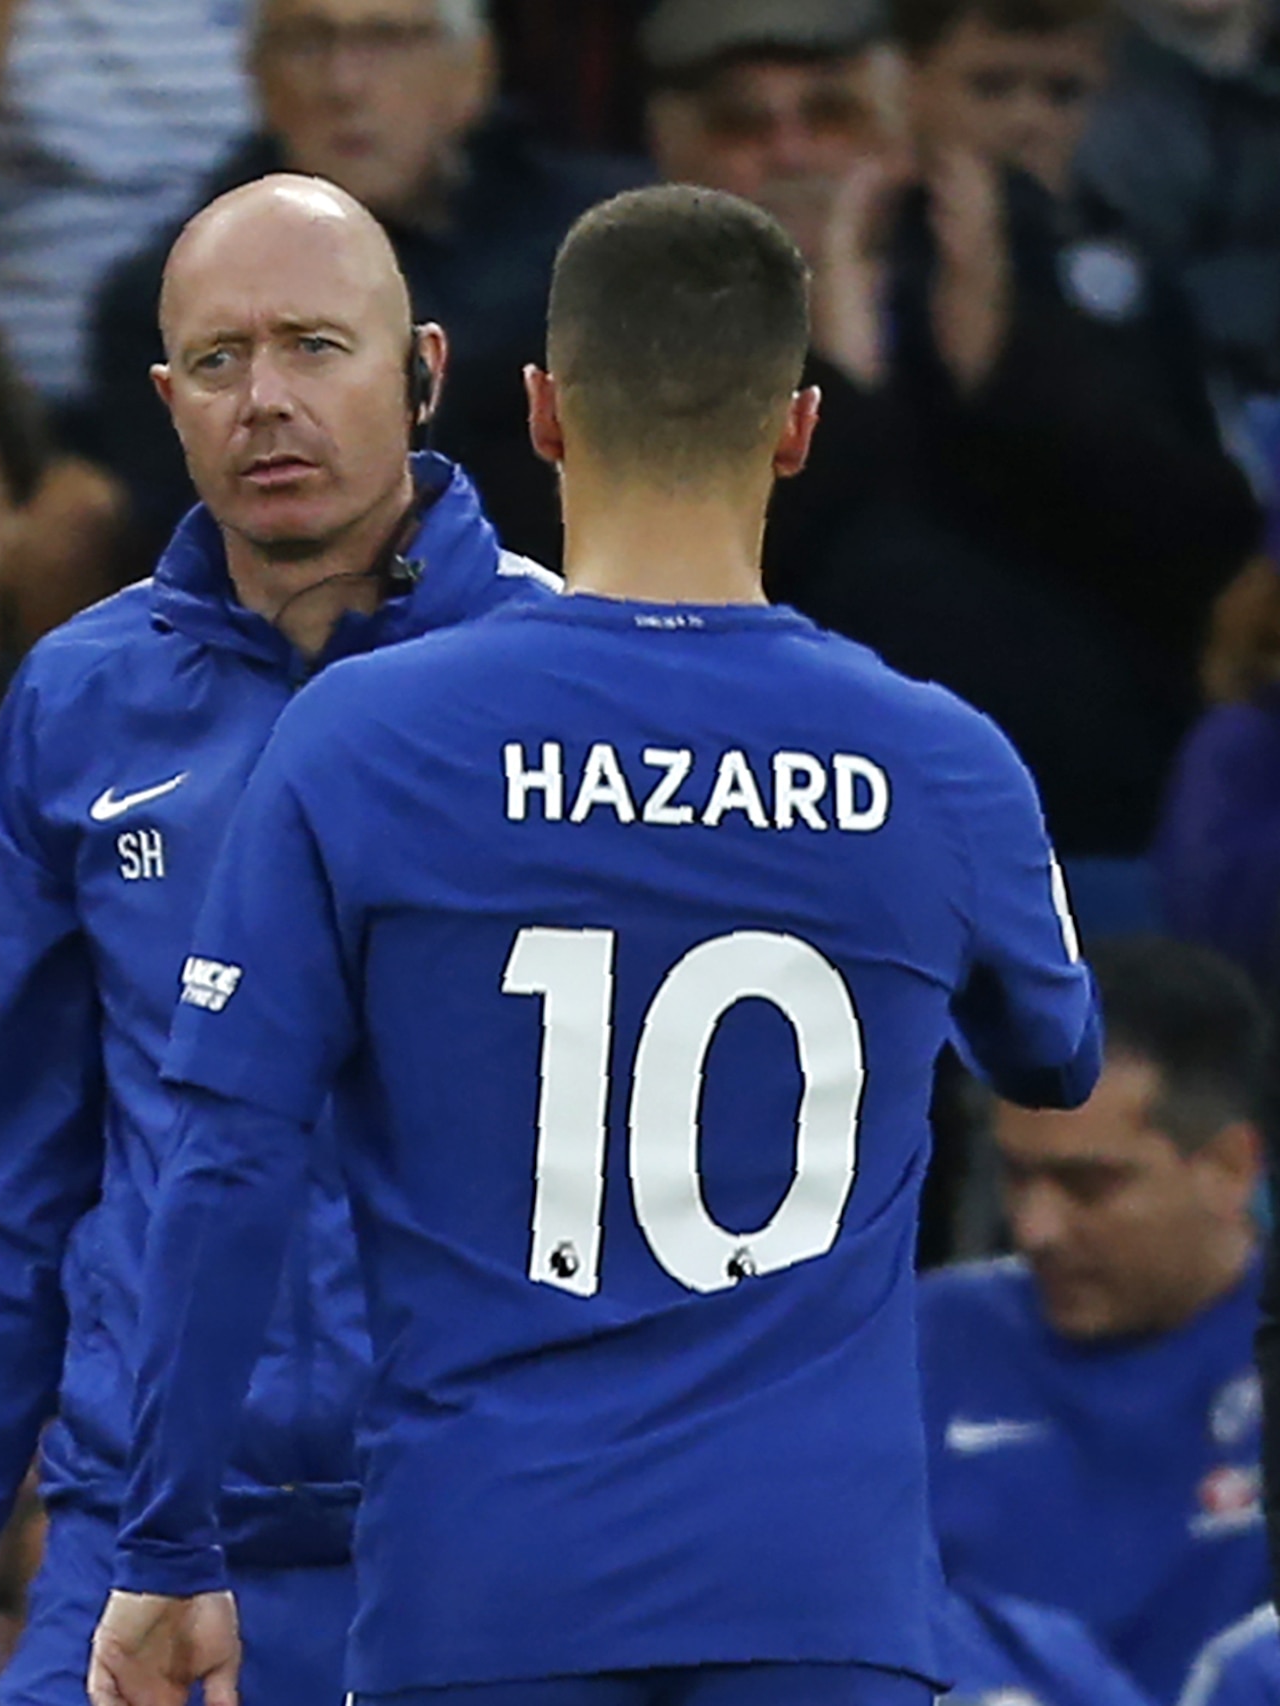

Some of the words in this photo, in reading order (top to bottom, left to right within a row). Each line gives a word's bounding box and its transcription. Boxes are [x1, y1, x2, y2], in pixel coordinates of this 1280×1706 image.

[505, 743, 887, 830] HAZARD
[118, 829, 164, 879] SH
[502, 927, 864, 1296] 10
